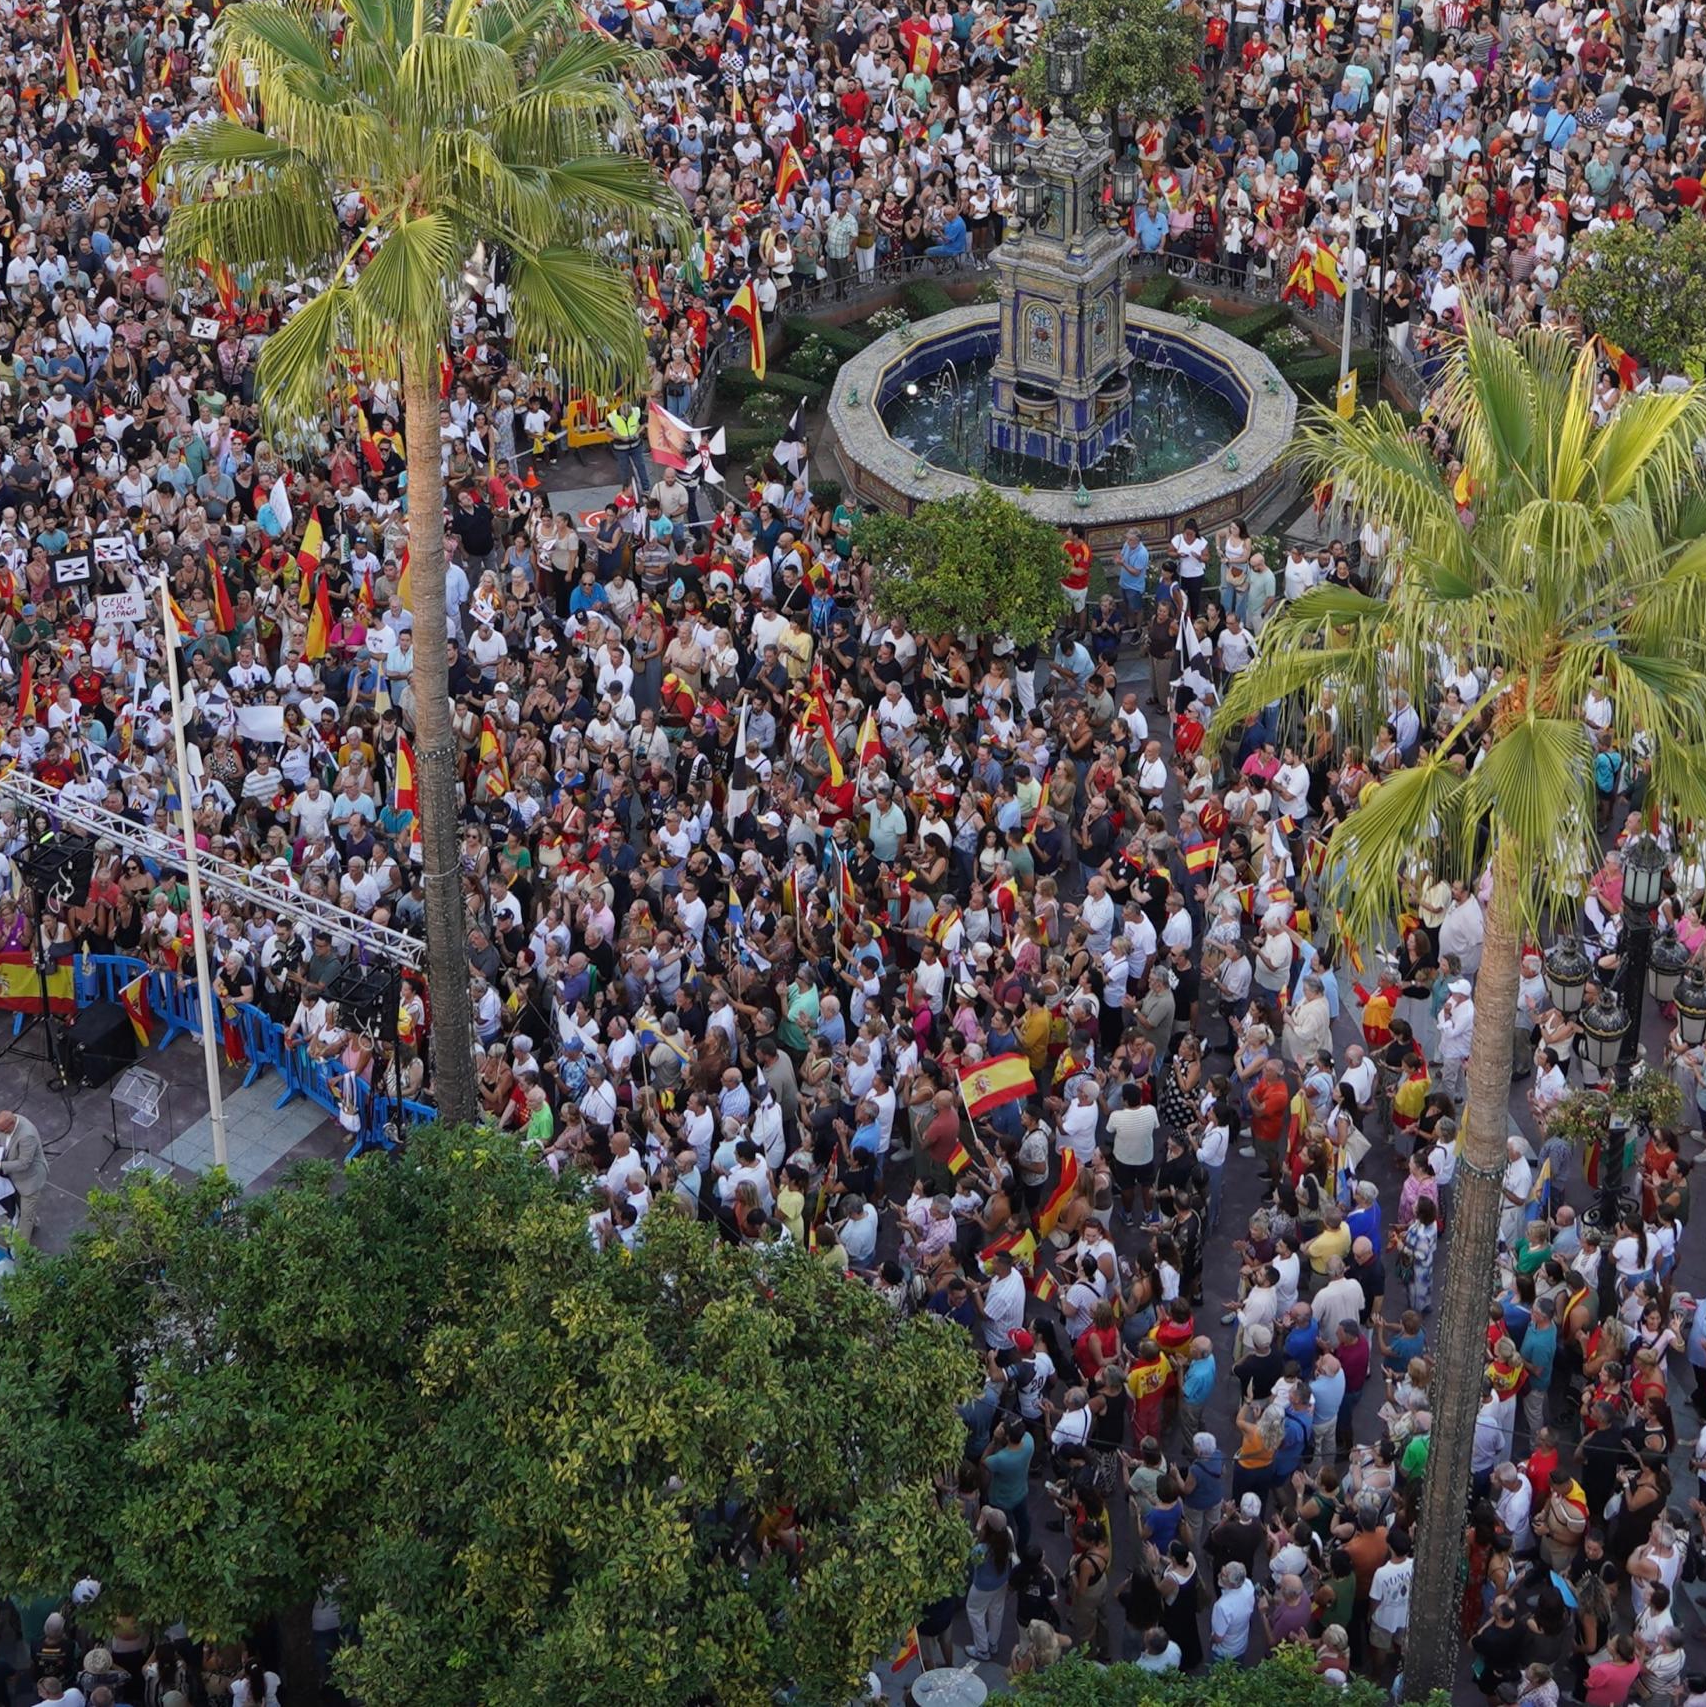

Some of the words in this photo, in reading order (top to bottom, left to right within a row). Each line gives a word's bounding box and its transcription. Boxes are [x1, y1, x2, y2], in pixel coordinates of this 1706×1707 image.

[101, 596, 132, 608] CEUTA
[105, 607, 137, 619] ESPAÑA
[1031, 1376, 1044, 1393] 20
